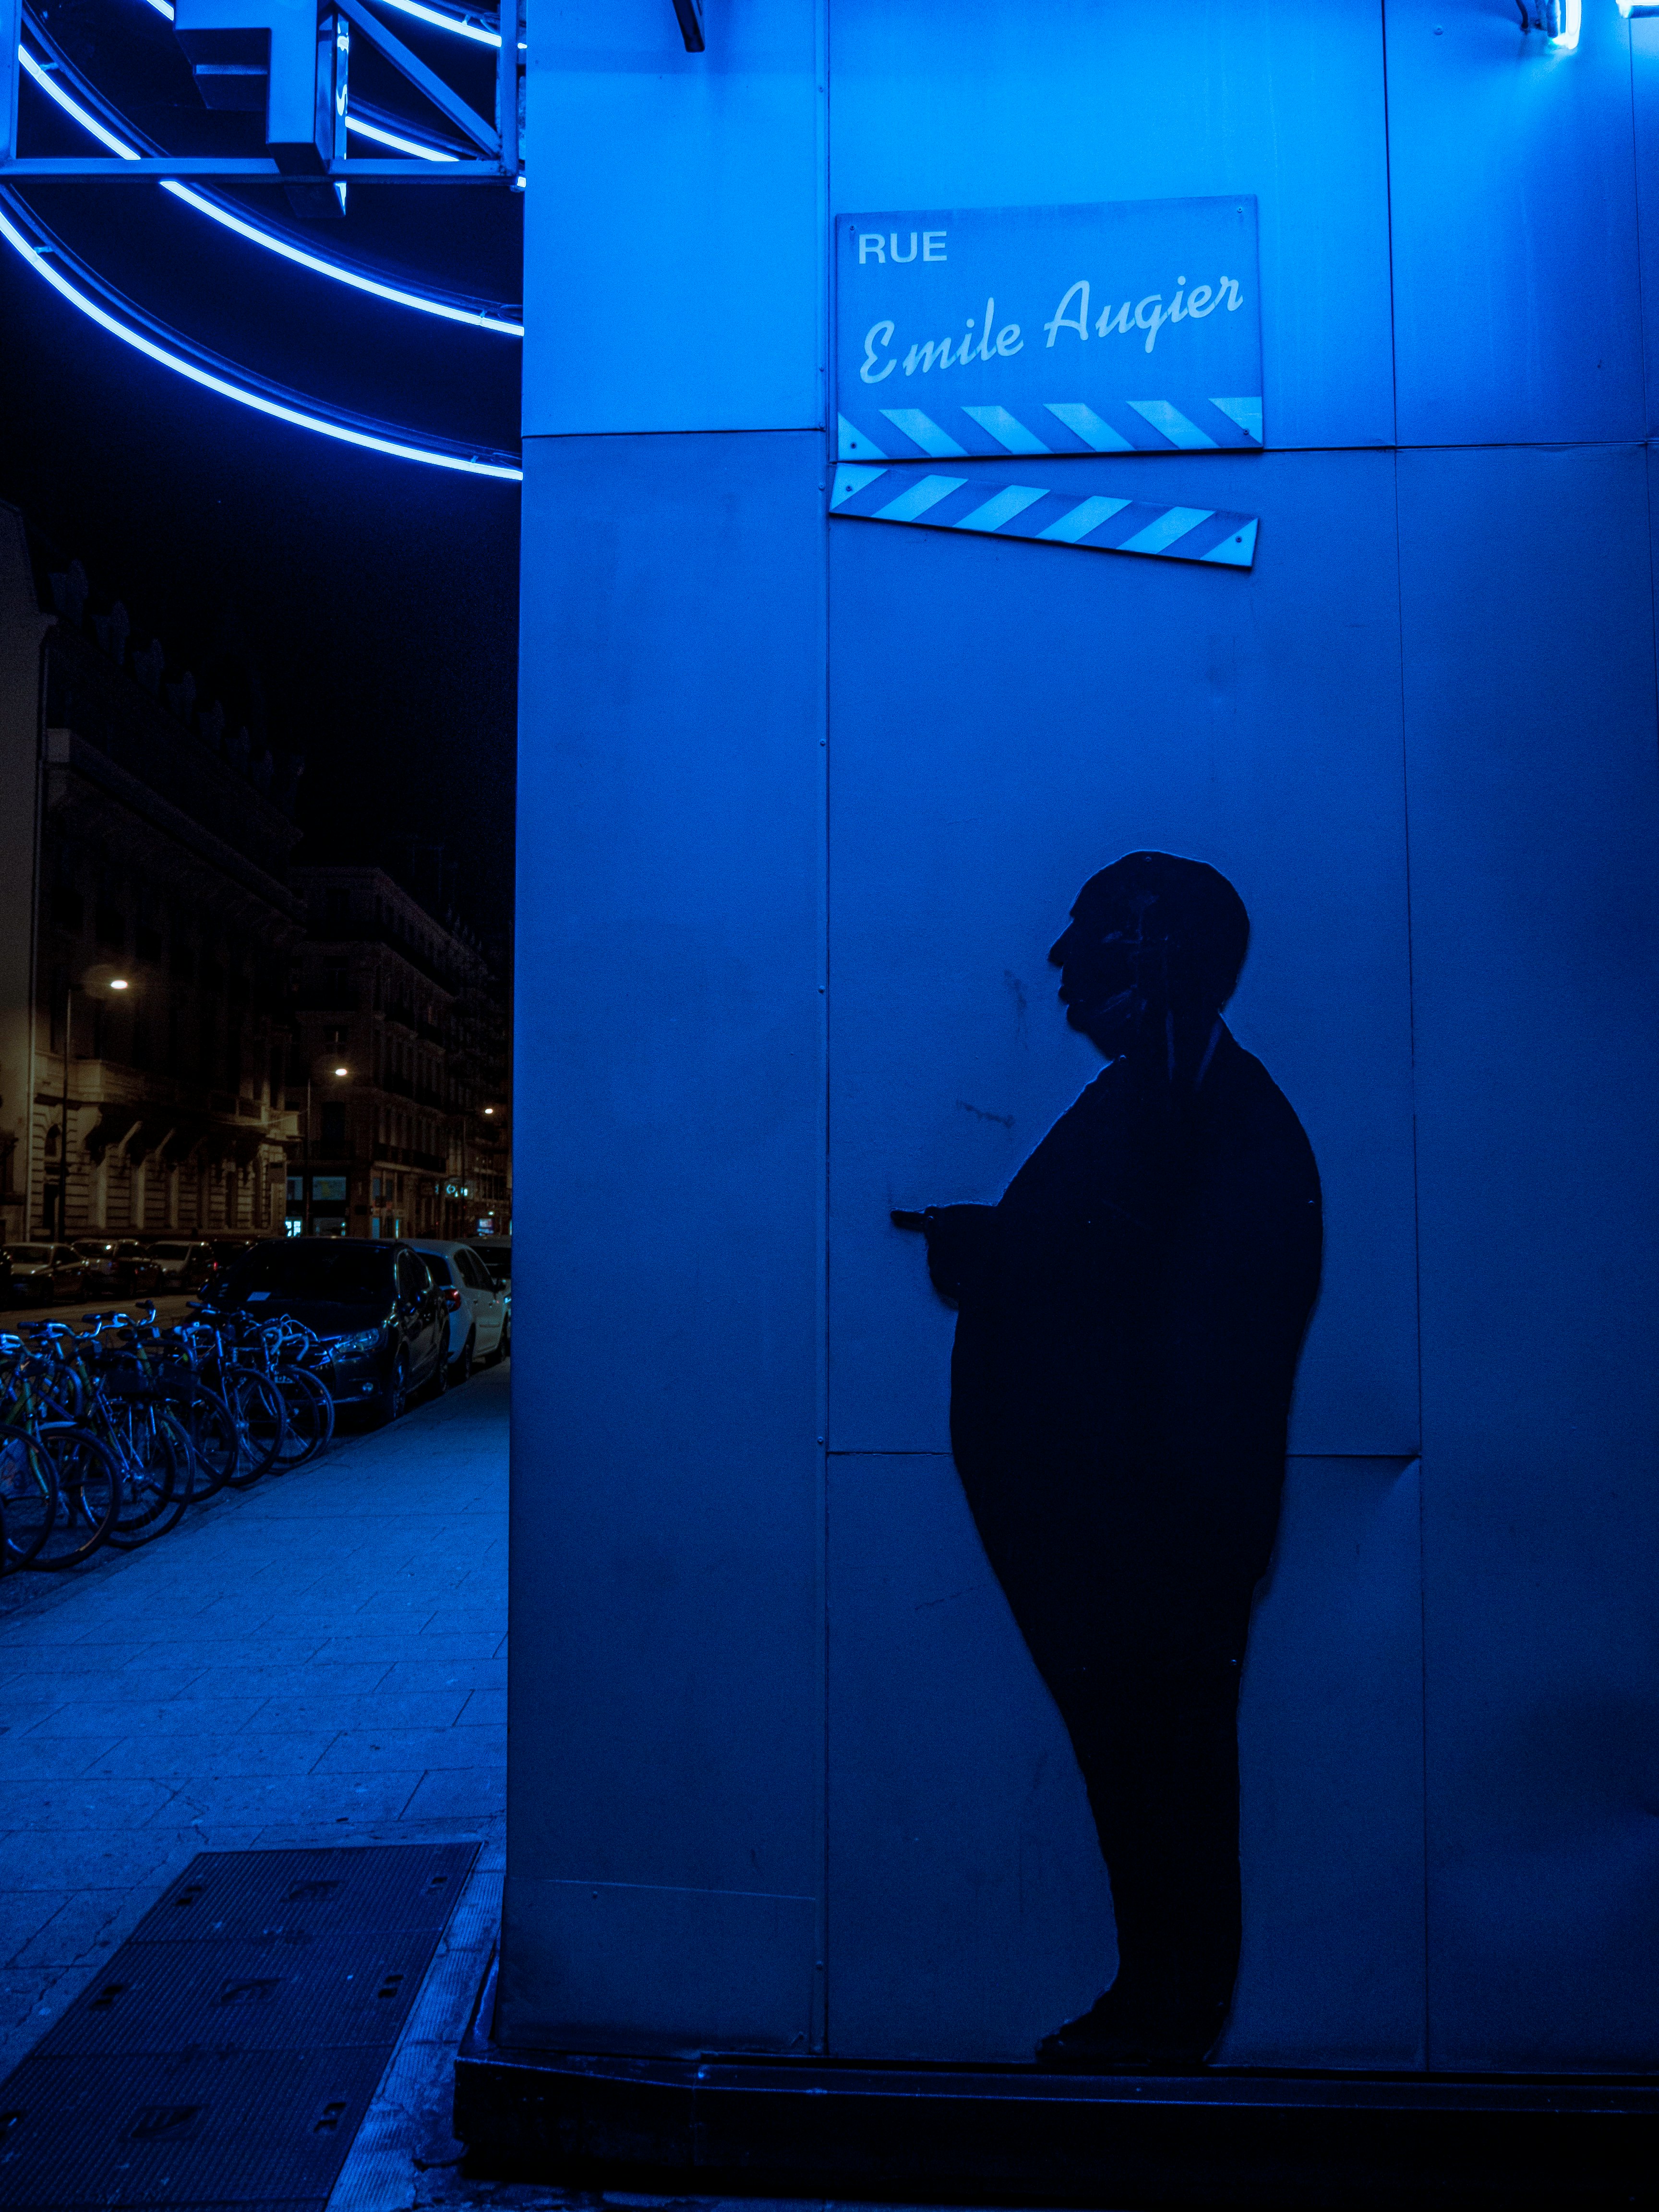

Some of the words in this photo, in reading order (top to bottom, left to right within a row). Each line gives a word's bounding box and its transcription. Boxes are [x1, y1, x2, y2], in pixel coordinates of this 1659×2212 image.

[859, 231, 948, 264] RUE
[860, 297, 1024, 384] Emile
[1044, 276, 1244, 353] Augier
